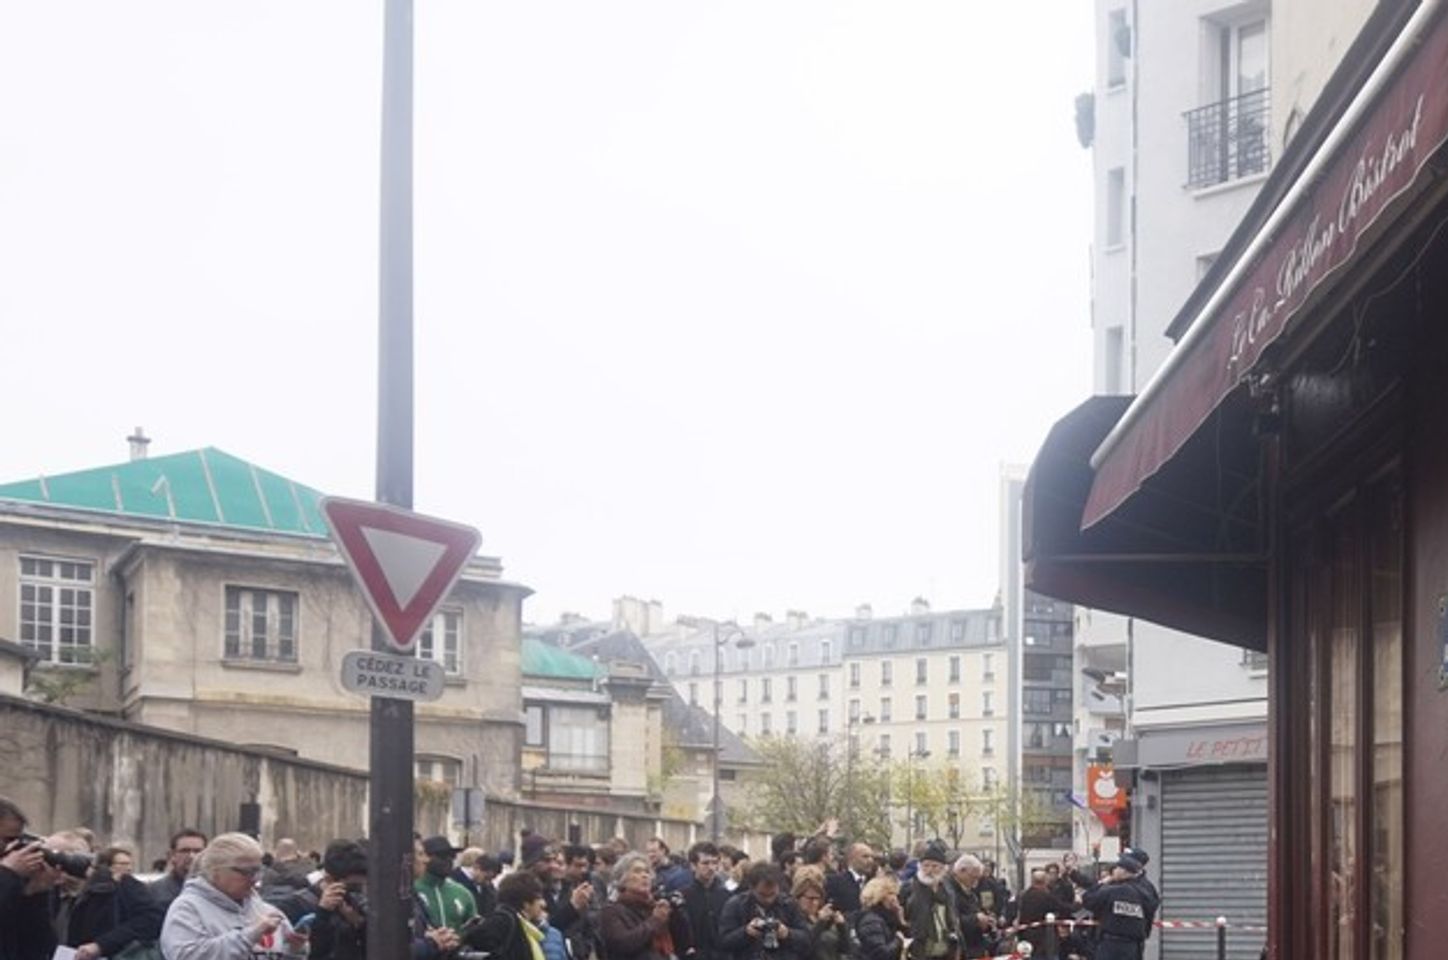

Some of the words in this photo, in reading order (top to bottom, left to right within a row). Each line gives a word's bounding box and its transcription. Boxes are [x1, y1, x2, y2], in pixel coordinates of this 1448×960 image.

[356, 657, 405, 676] CÉDEZ
[413, 663, 431, 680] LE
[356, 674, 429, 695] PASSAGE
[1186, 740, 1208, 759] LE
